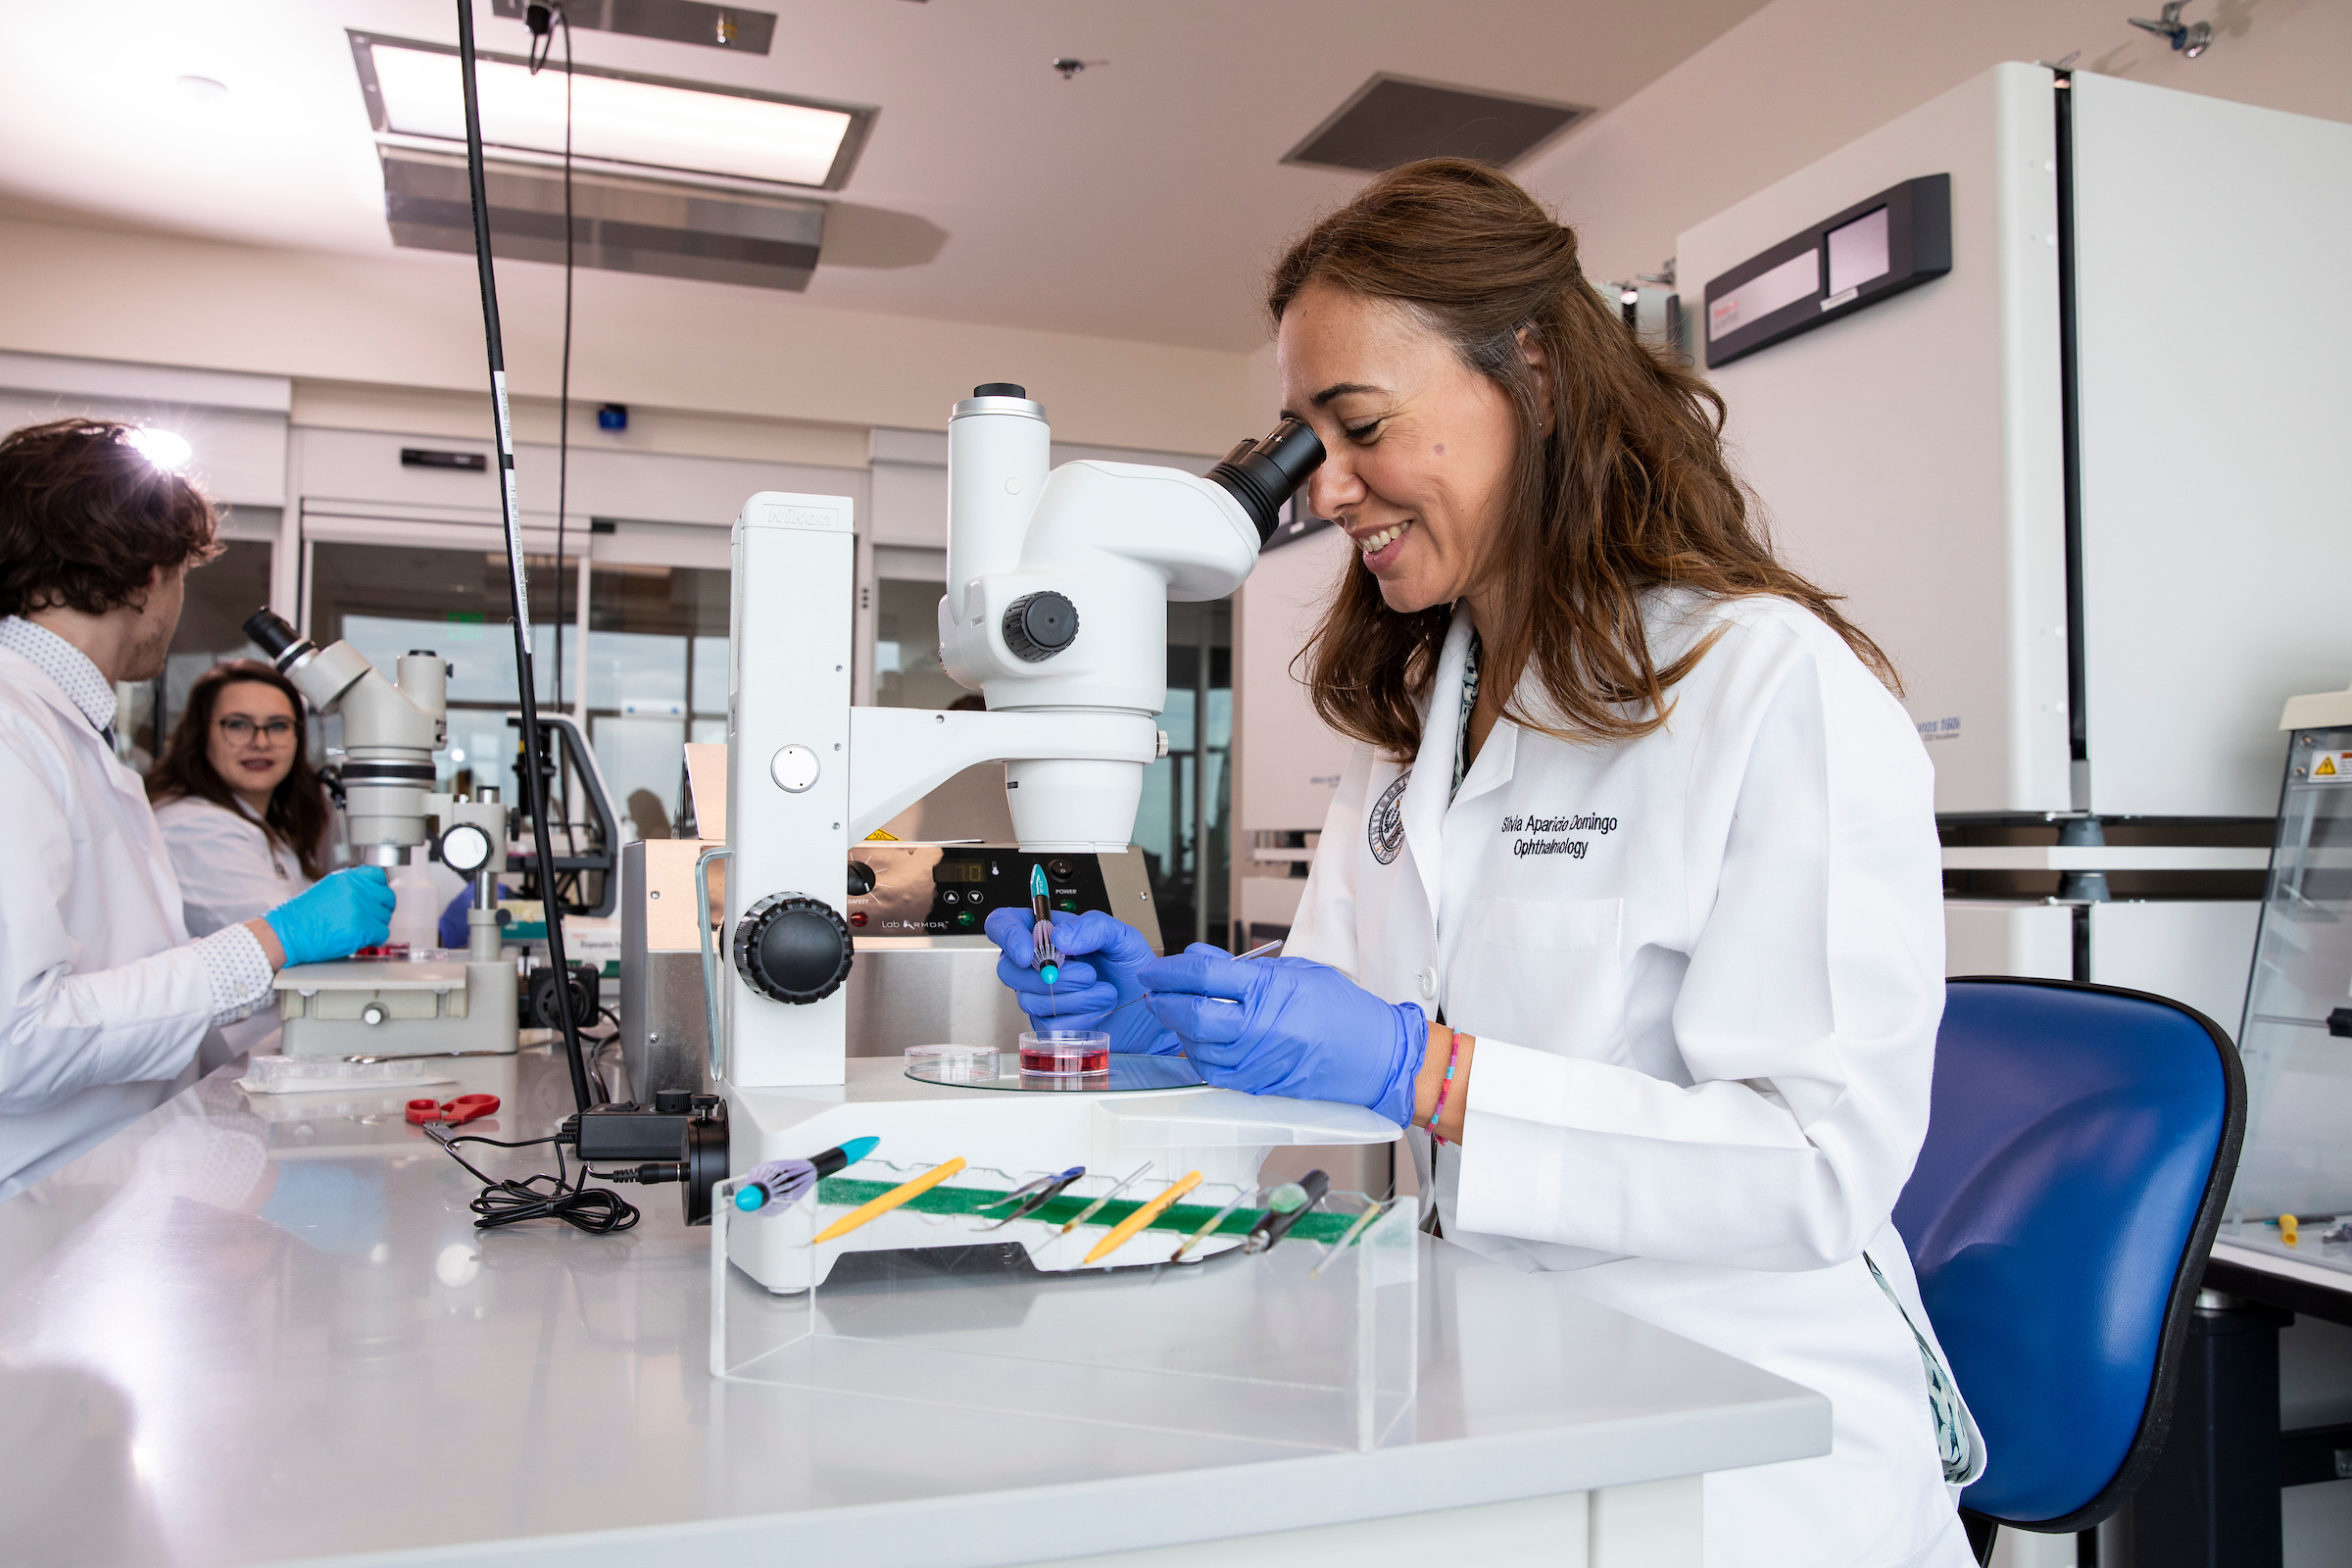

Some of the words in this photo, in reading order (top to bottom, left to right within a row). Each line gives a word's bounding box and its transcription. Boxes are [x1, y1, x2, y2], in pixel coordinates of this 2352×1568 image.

[767, 506, 833, 527] Nikon
[1501, 815, 1523, 833] Silvia
[1525, 815, 1569, 835] Aparicio
[1569, 812, 1618, 835] Domingo
[1513, 838, 1589, 858] Ophthalmology
[881, 920, 901, 929] Lab
